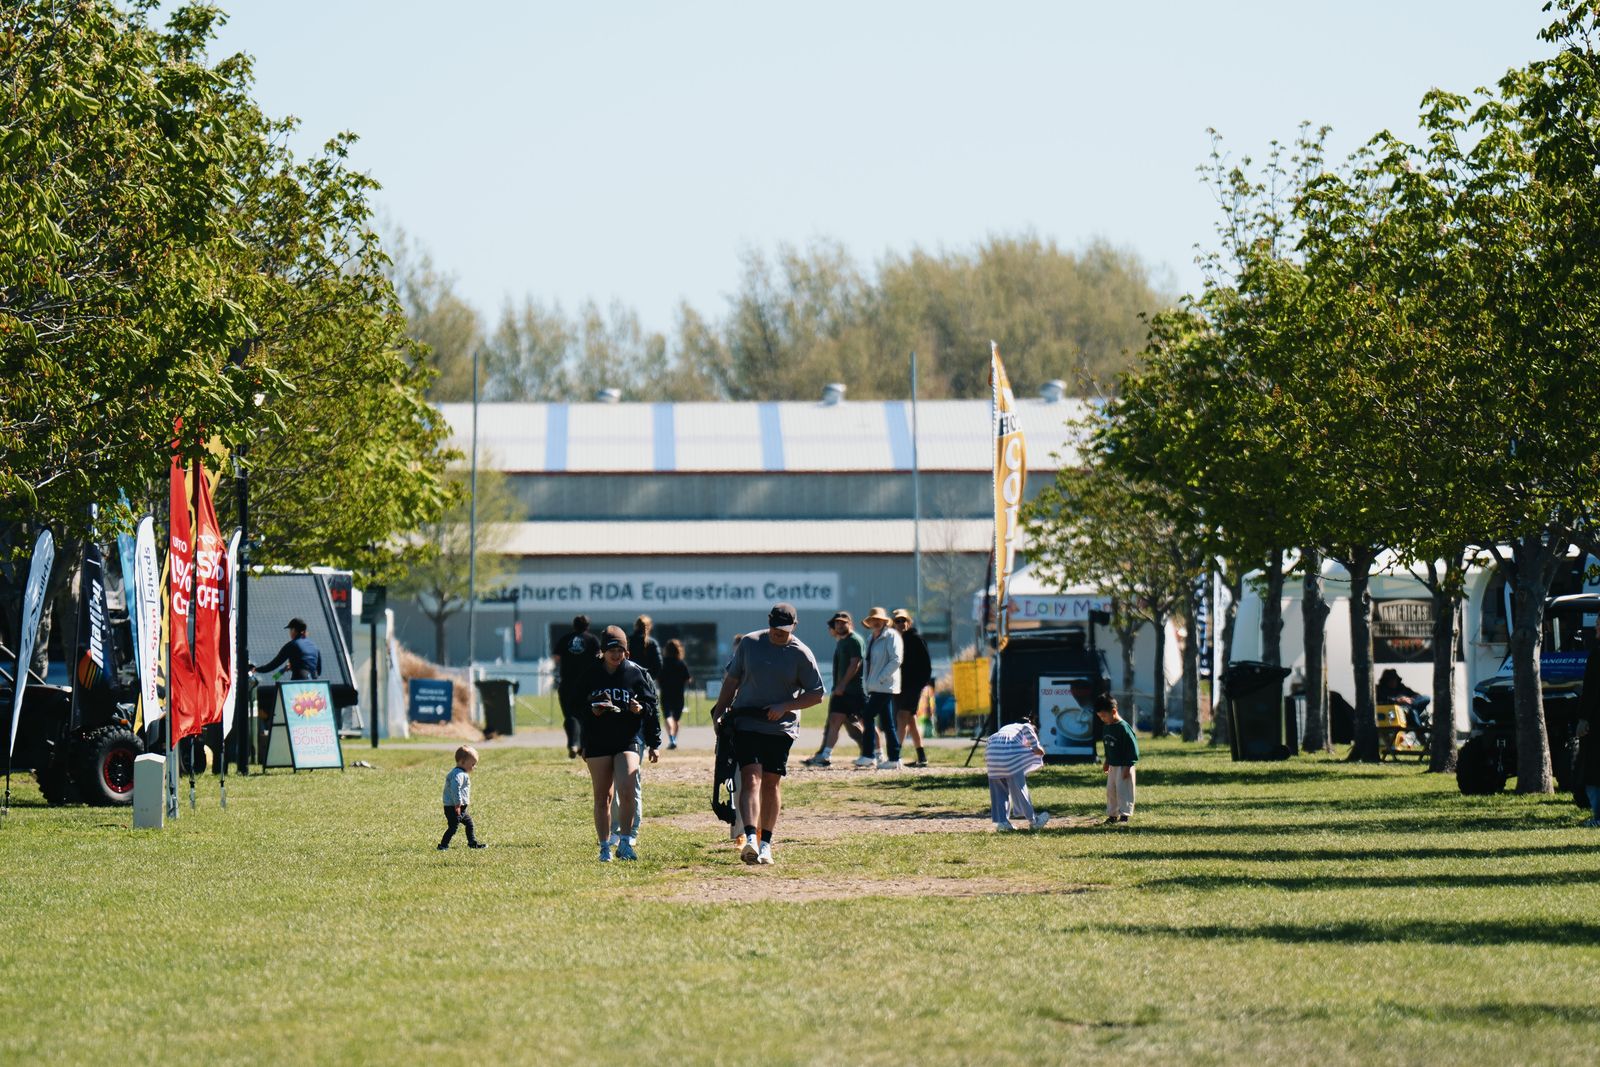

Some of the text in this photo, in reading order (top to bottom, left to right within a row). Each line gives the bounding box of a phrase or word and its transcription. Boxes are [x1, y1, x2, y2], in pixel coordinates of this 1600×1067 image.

[196, 550, 224, 580] 5%
[197, 585, 224, 612] OFF!
[589, 582, 633, 600] RDA
[641, 581, 755, 603] Equestrian
[763, 582, 832, 600] Centre
[1024, 600, 1066, 617] Lolly
[293, 735, 335, 745] DONUTS
